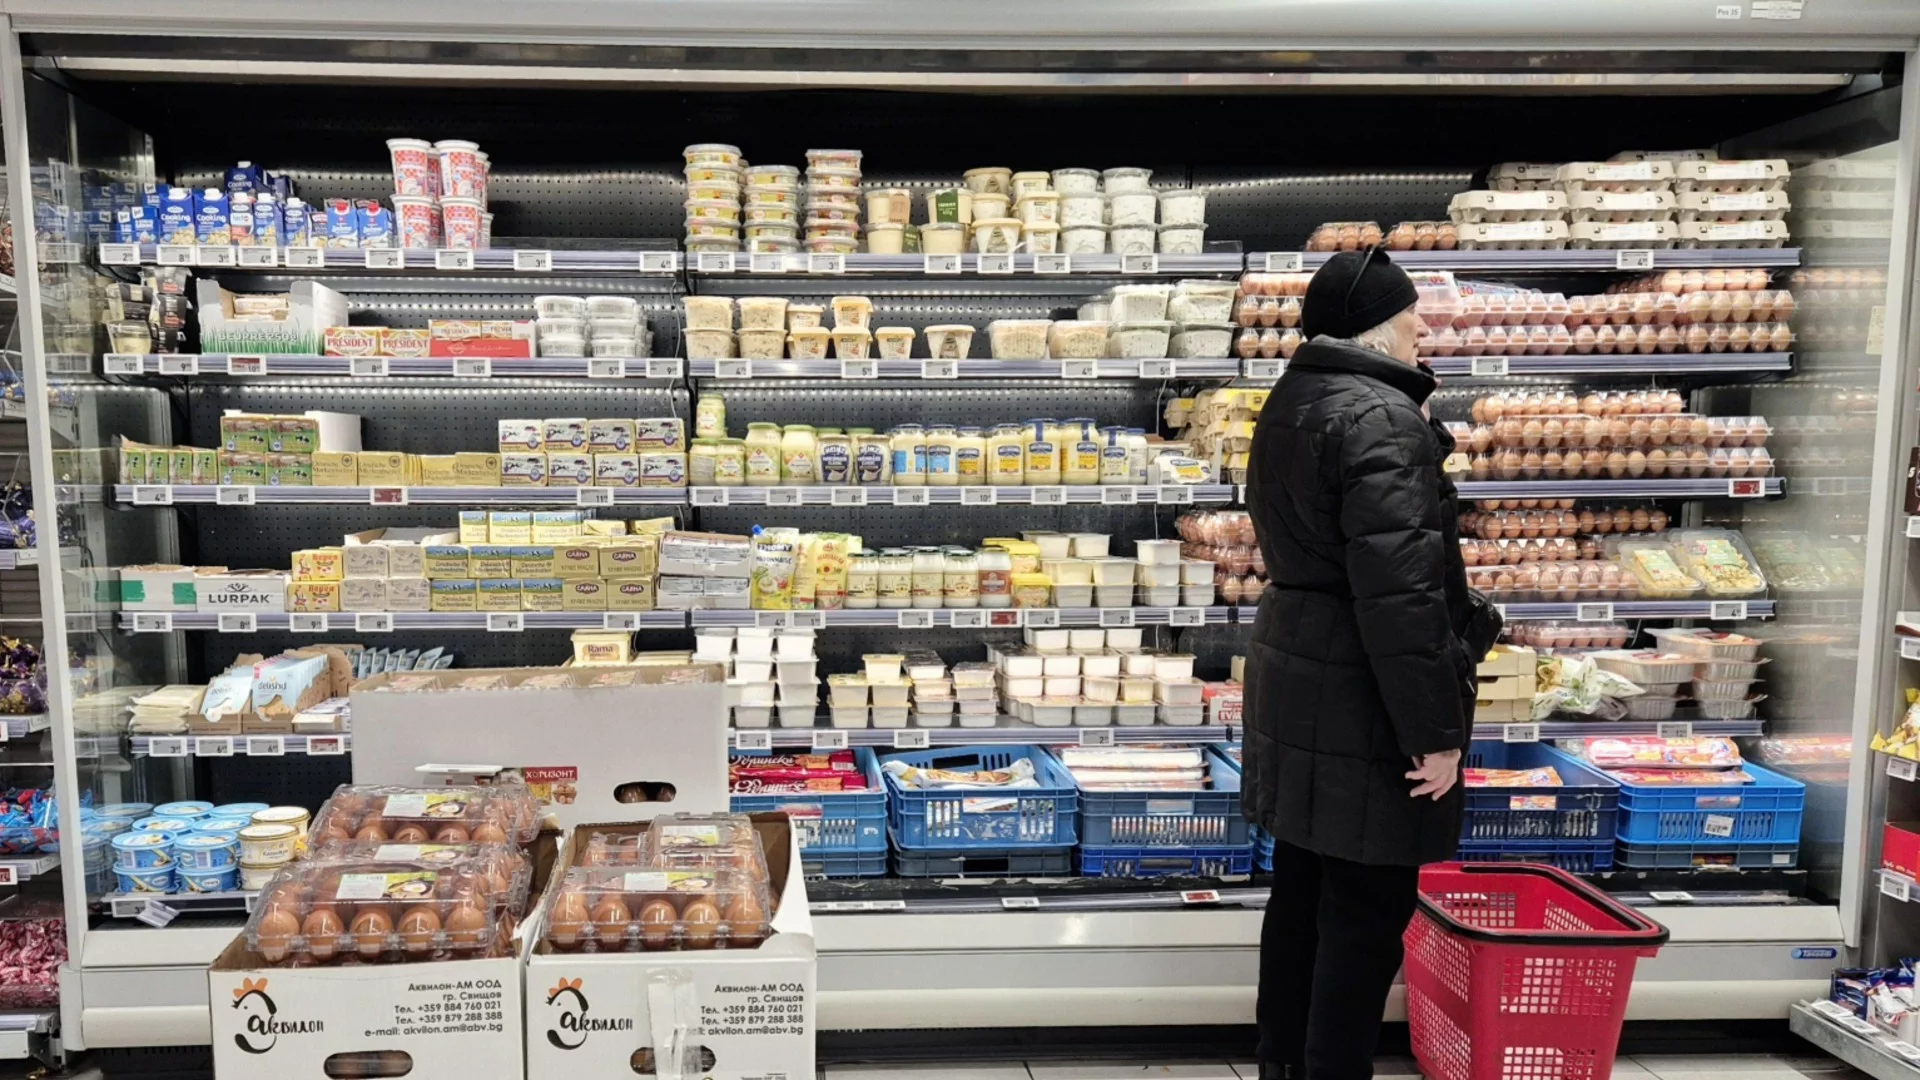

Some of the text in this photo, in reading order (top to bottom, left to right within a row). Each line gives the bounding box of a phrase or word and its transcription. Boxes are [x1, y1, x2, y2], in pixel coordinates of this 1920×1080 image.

[160, 213, 191, 223] Cooking
[196, 213, 227, 223] Cooking
[208, 594, 270, 603] LURPAK
[588, 645, 613, 653] Rama
[525, 770, 575, 779] ХОРИЗОНТ
[408, 980, 502, 992] Аквилон-АМ ООД
[714, 983, 804, 993] Аквилон-АМ ООД
[443, 991, 502, 1002] гр. Свищов
[747, 994, 804, 1004] гр. Свищов
[395, 1001, 501, 1014] Тел. +359 884 760 021
[701, 1004, 803, 1014] Тел. +359 884 760 021
[396, 1012, 503, 1025] Тел. +359 879 288 388
[701, 1015, 804, 1025] Тел. +359 879 288 388
[364, 1022, 503, 1037] e-mail: akvilon.am@abv.bg
[708, 1025, 804, 1037] akvilon.am@abv.bg
